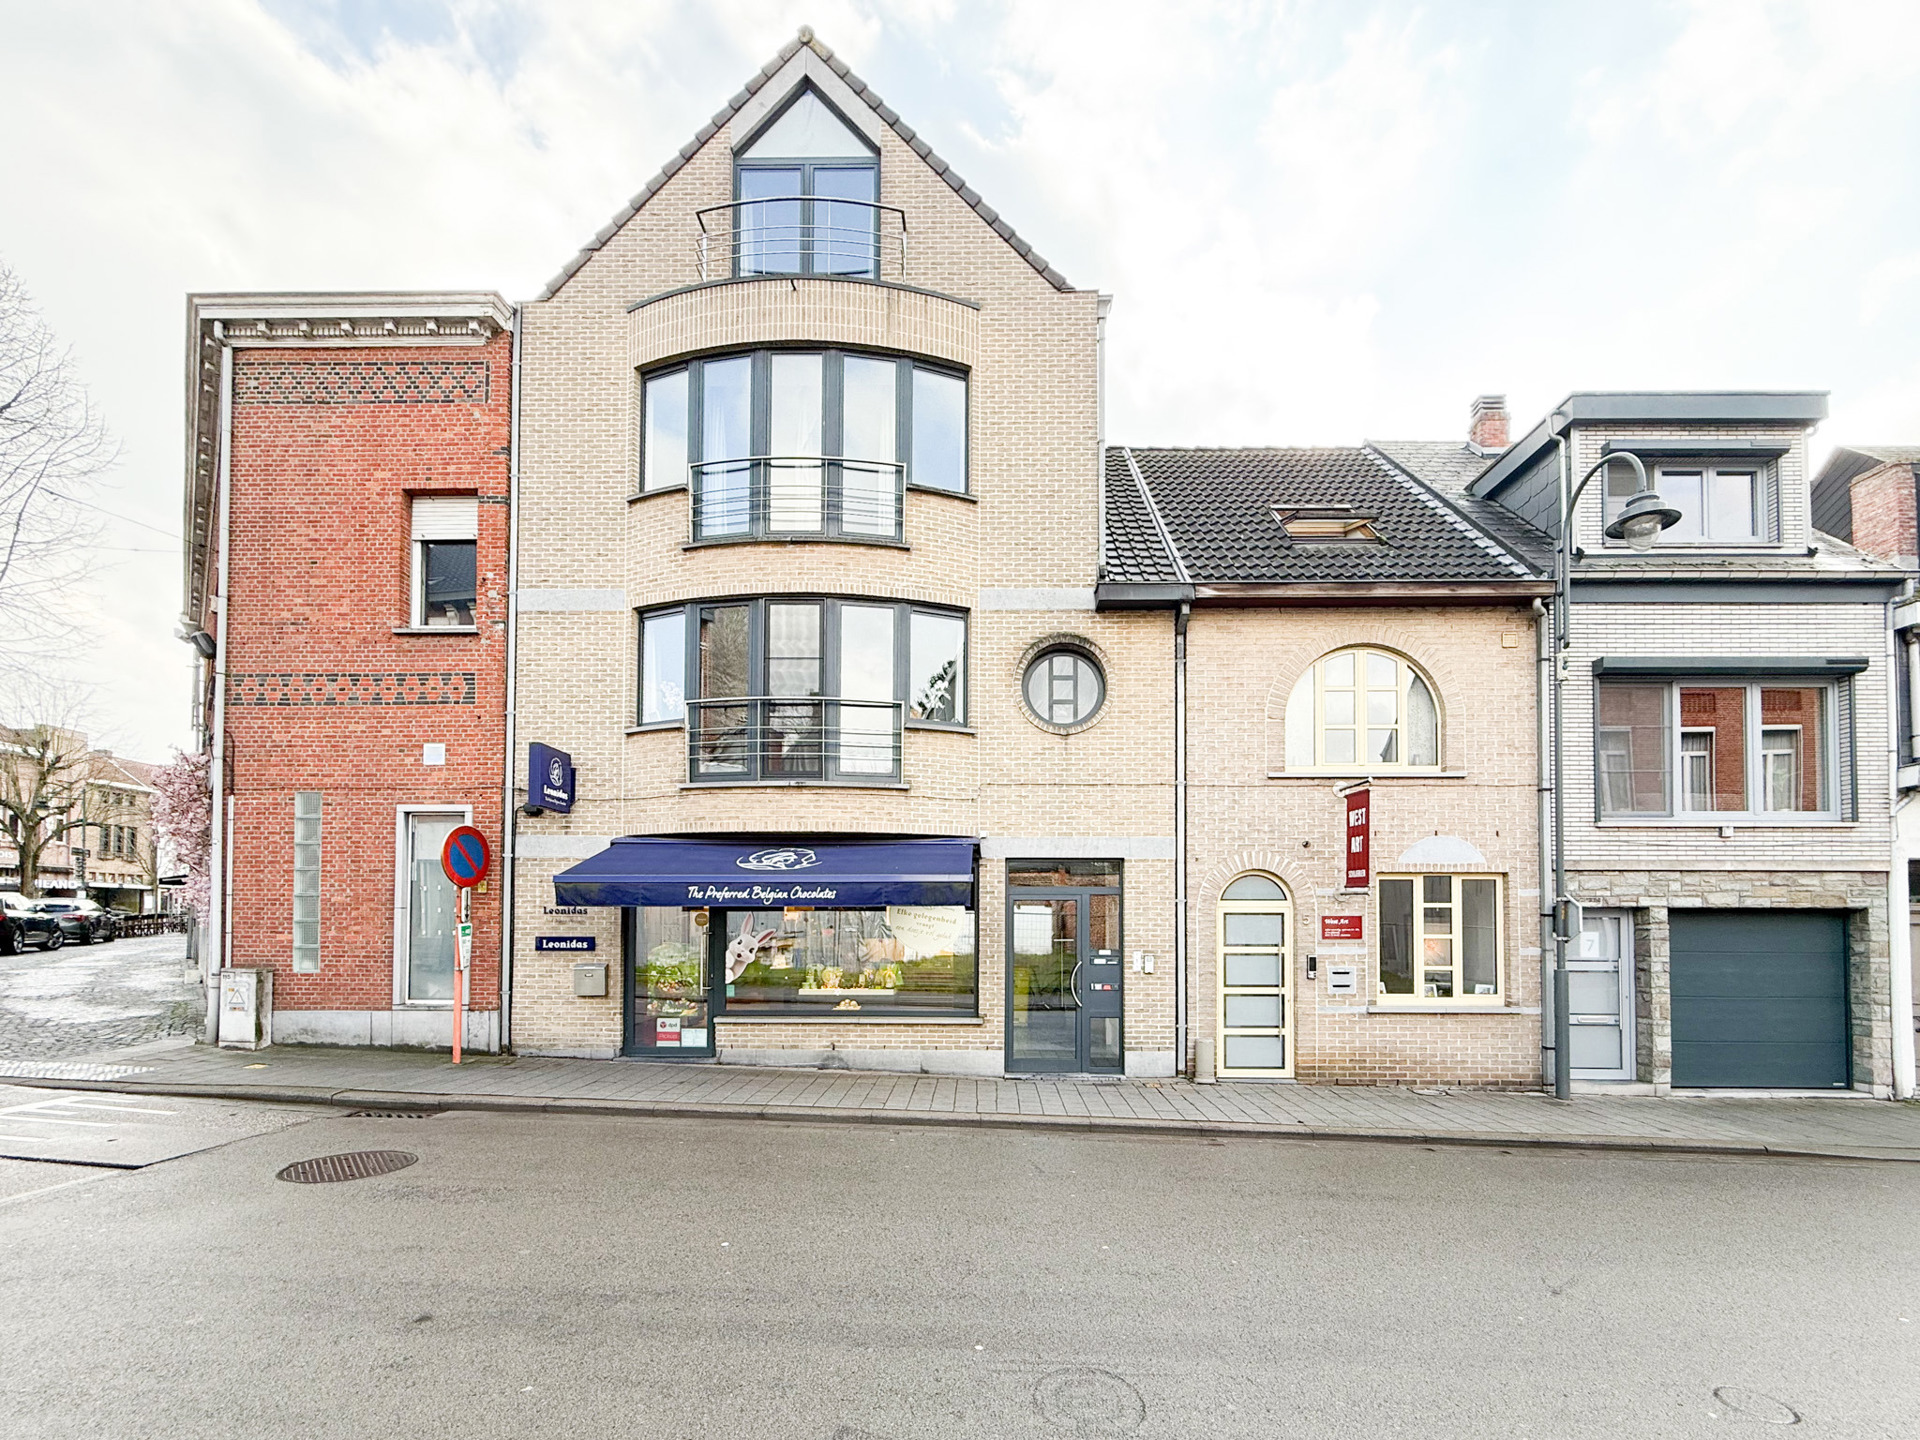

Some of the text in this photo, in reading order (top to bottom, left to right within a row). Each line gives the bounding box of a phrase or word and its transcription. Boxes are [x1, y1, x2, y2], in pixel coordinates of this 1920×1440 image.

[1349, 807, 1366, 827] WEST
[1350, 835, 1364, 853] ART
[687, 885, 837, 905] The Preferred Belgian Chocolates
[543, 906, 588, 915] Leonidas
[913, 912, 957, 925] gelegenheid
[1302, 914, 1310, 925] 5
[542, 939, 588, 949] Leonidas
[1585, 939, 1595, 951] 7
